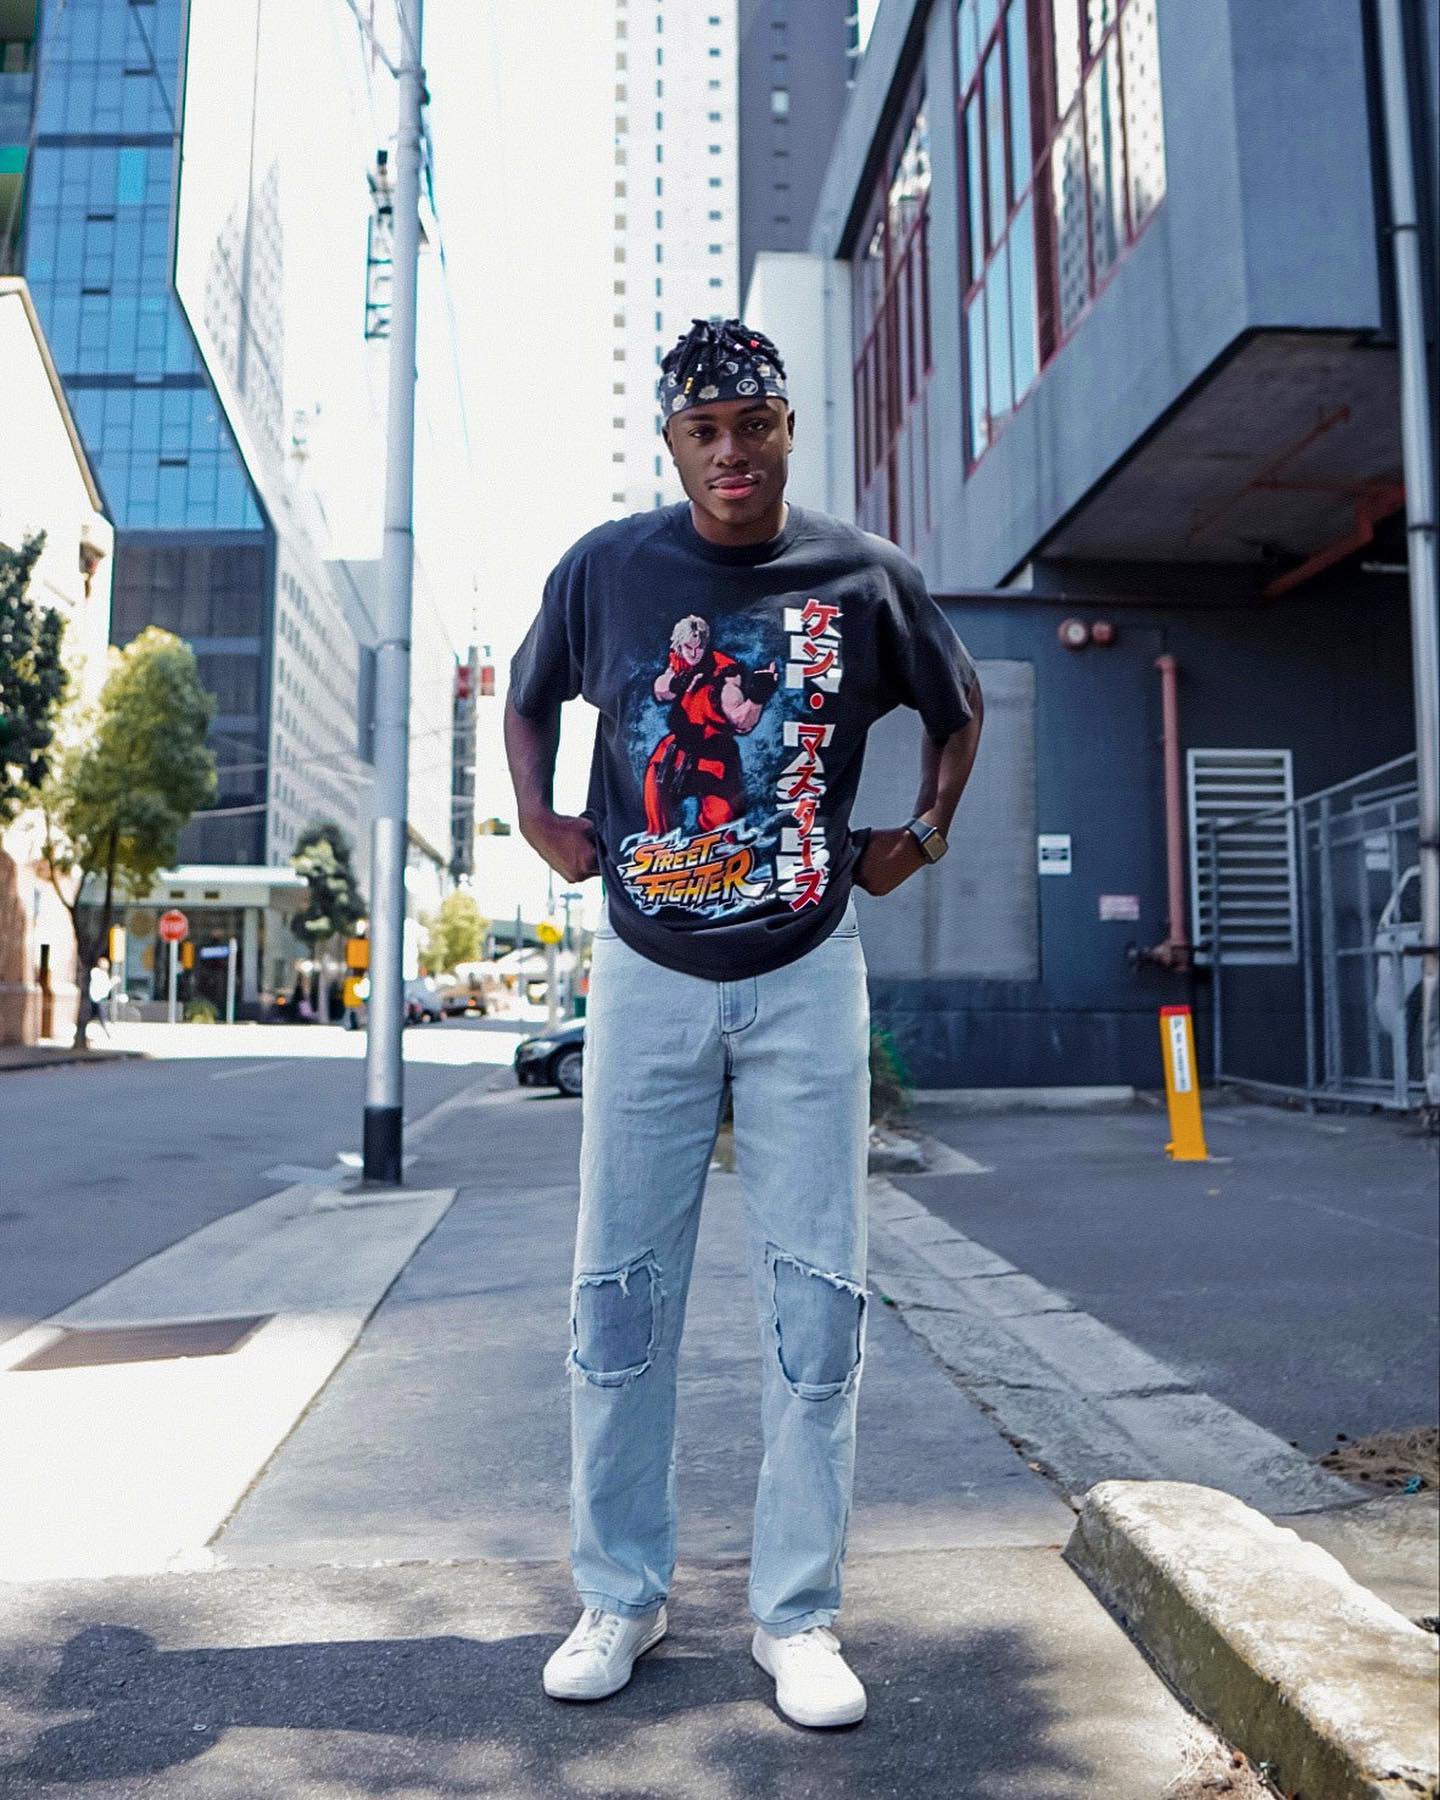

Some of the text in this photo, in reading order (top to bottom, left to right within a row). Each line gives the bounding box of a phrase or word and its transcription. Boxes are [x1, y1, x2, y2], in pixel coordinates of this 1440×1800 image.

[788, 598, 840, 913] ケン・マスターズ
[619, 833, 723, 879] STREET
[633, 848, 771, 905] FIGHTER
